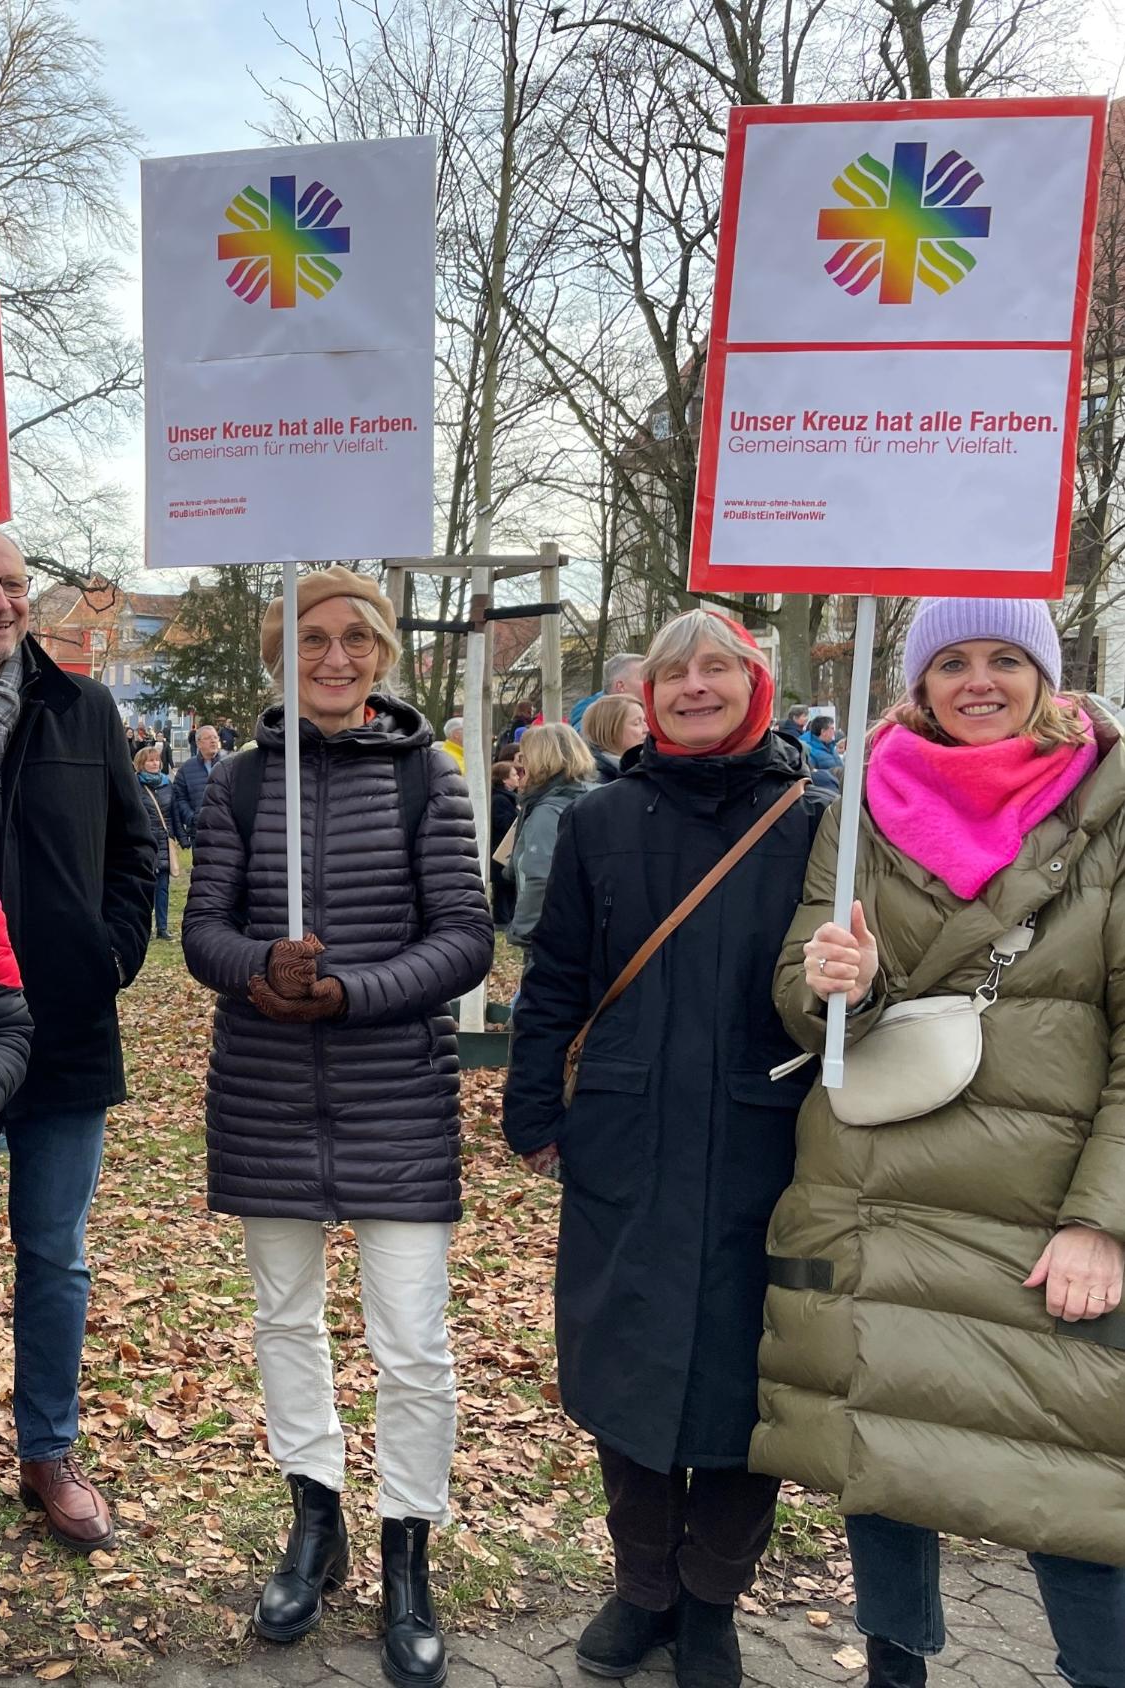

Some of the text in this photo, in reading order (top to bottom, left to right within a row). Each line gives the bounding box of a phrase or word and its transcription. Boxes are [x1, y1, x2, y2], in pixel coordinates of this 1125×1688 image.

[168, 415, 417, 443] Unser Kreuz hat alle Farben.
[730, 410, 1058, 432] Unser Kreuz hat alle Farben.
[168, 437, 388, 462] Gemeinsam für mehr Vielfalt.
[728, 435, 1017, 454] Gemeinsam für mehr Vielfalt.
[723, 510, 826, 520] #DuBistEinTeilVonWir
